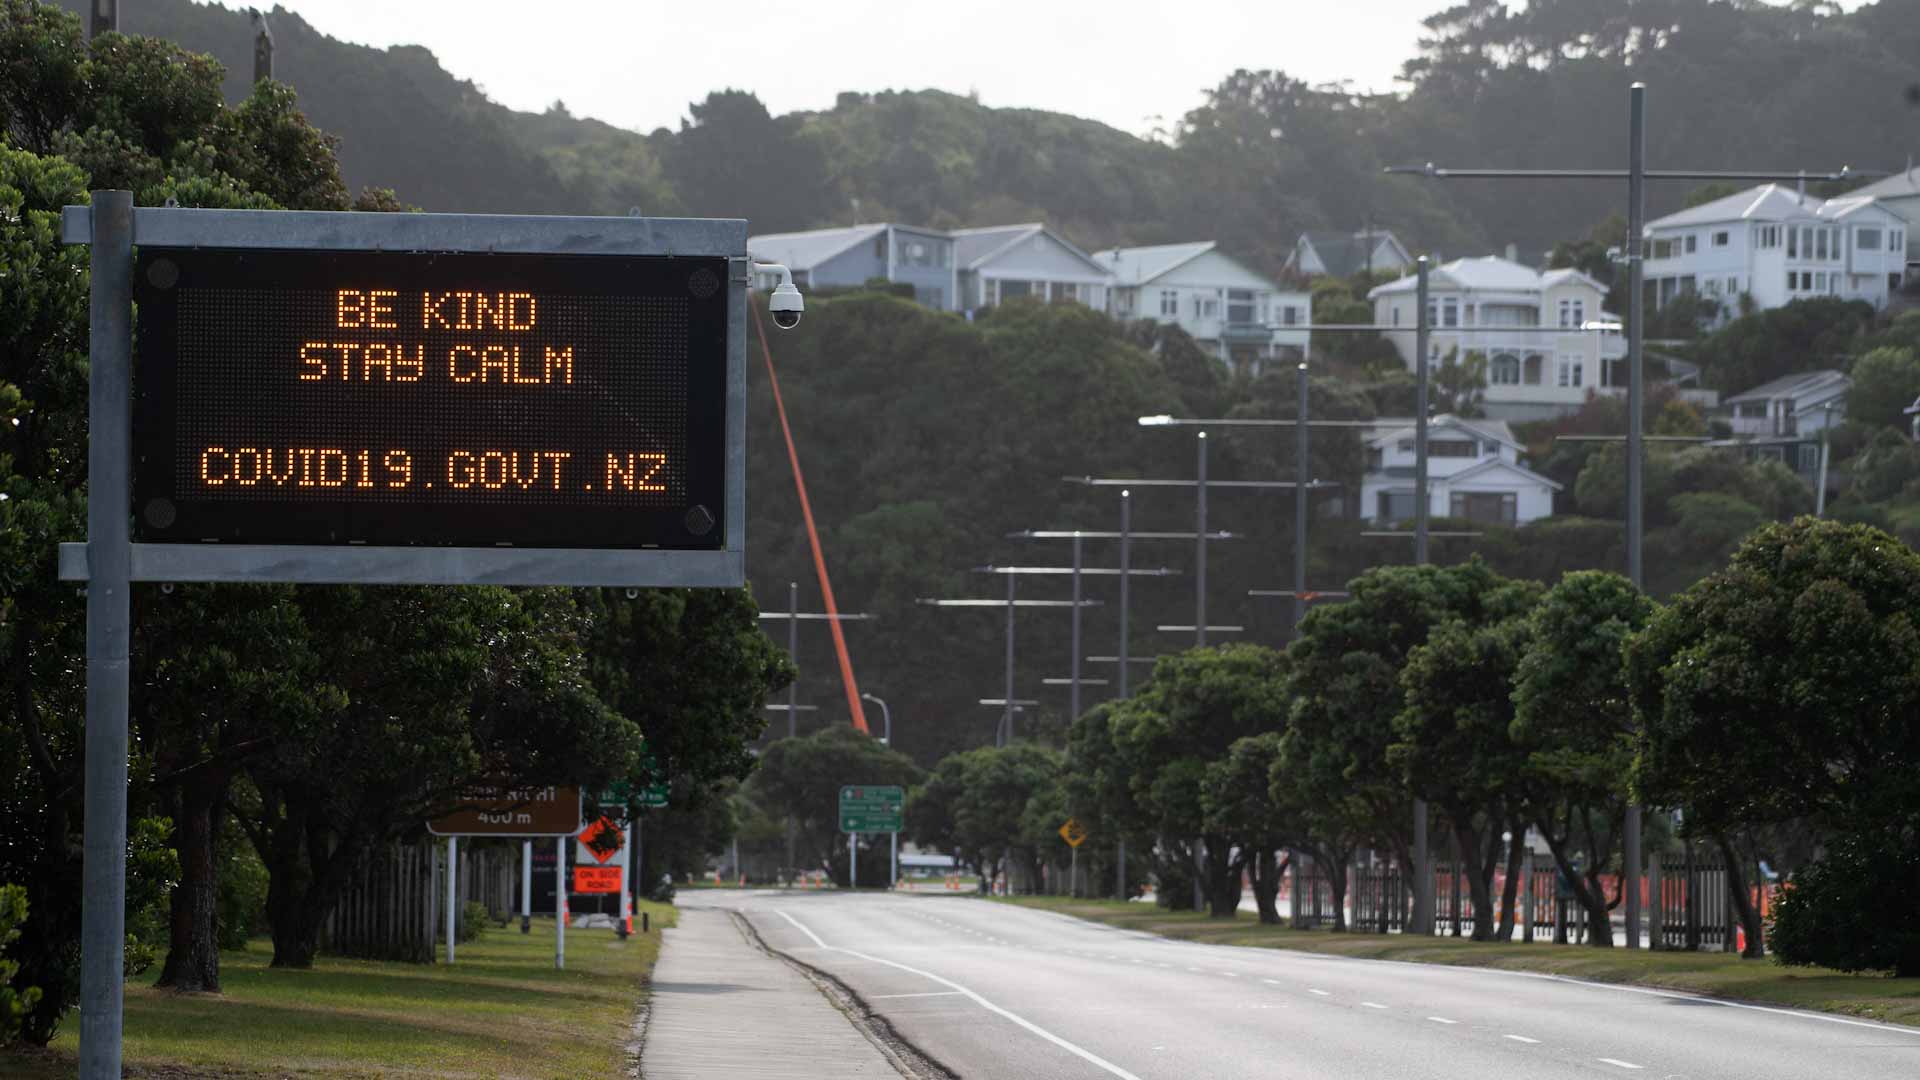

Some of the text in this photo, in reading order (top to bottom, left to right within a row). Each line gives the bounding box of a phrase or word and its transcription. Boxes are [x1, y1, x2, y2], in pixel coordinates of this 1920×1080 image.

[338, 290, 536, 331] BE KIND
[300, 342, 572, 384] STAY CALM
[516, 813, 532, 824] m
[579, 869, 594, 879] ON
[599, 868, 620, 879] SIDE
[586, 880, 614, 889] ROAD
